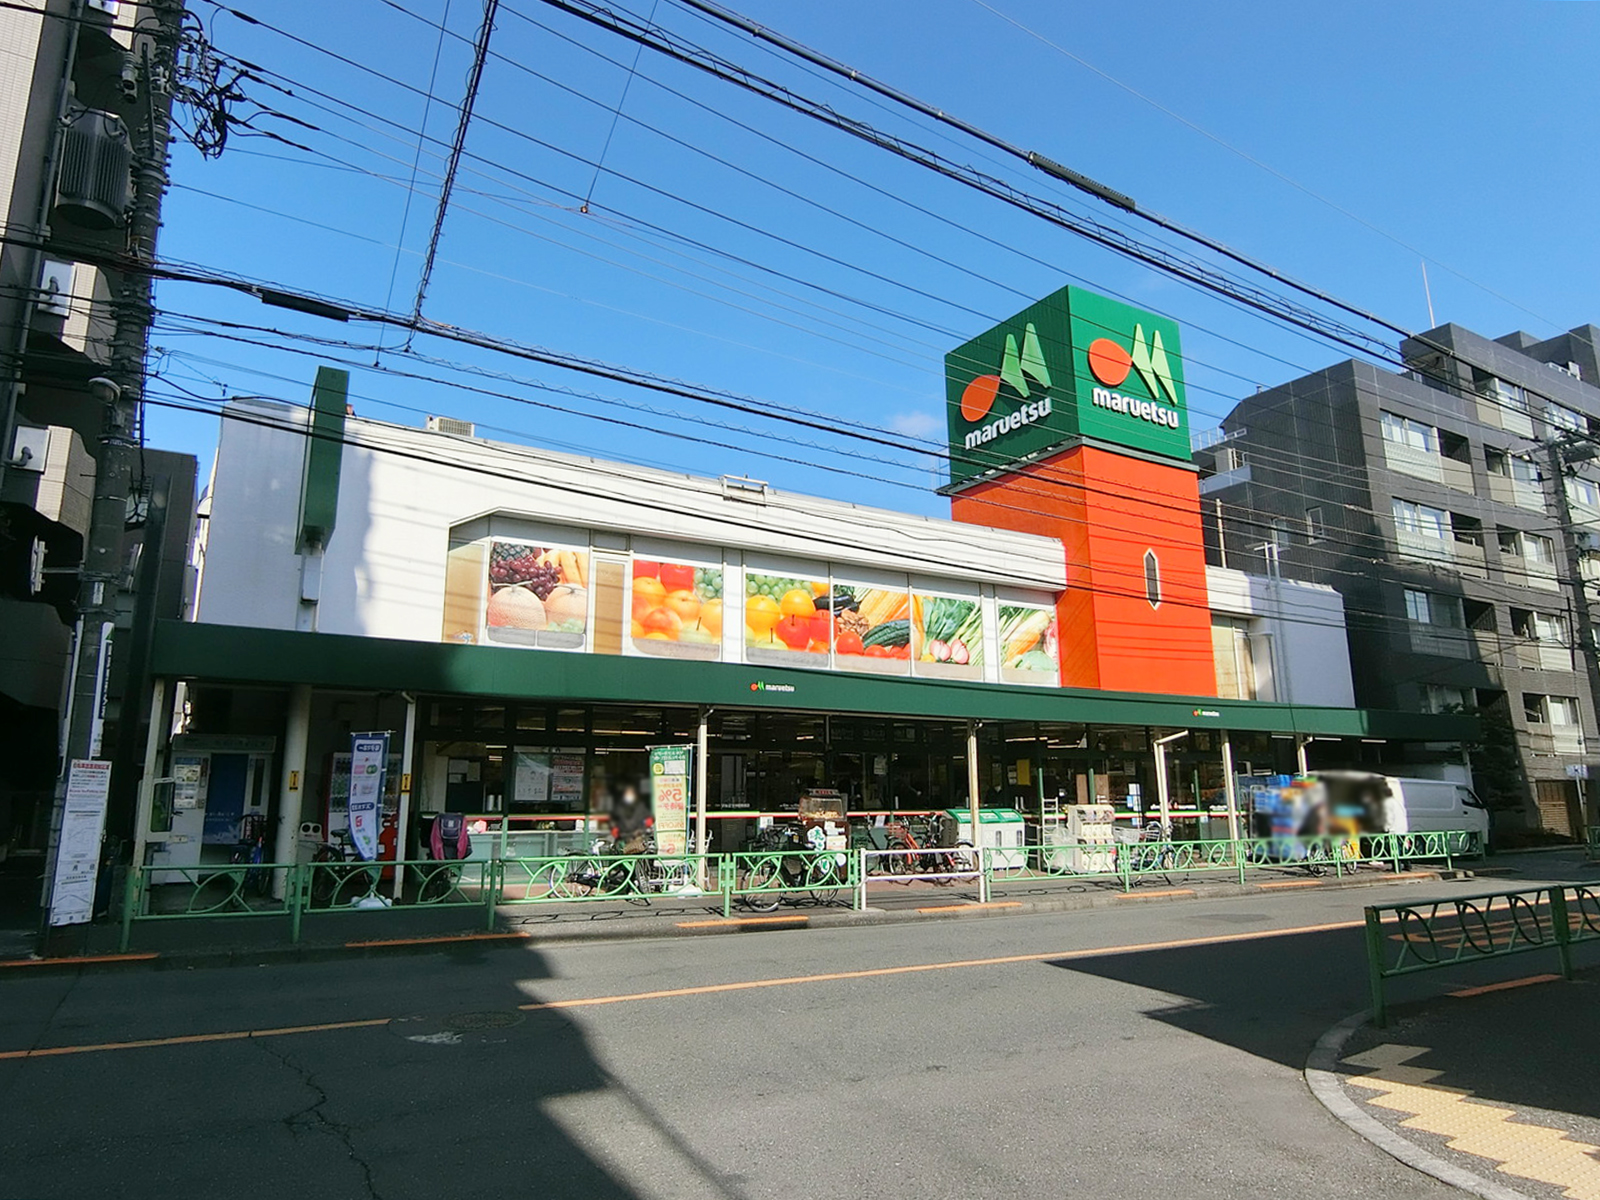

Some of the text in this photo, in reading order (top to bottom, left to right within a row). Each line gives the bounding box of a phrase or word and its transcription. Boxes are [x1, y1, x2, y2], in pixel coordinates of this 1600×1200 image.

[965, 397, 1052, 450] maruetsu
[1092, 387, 1179, 428] maruetsu
[765, 683, 795, 692] maruetsu
